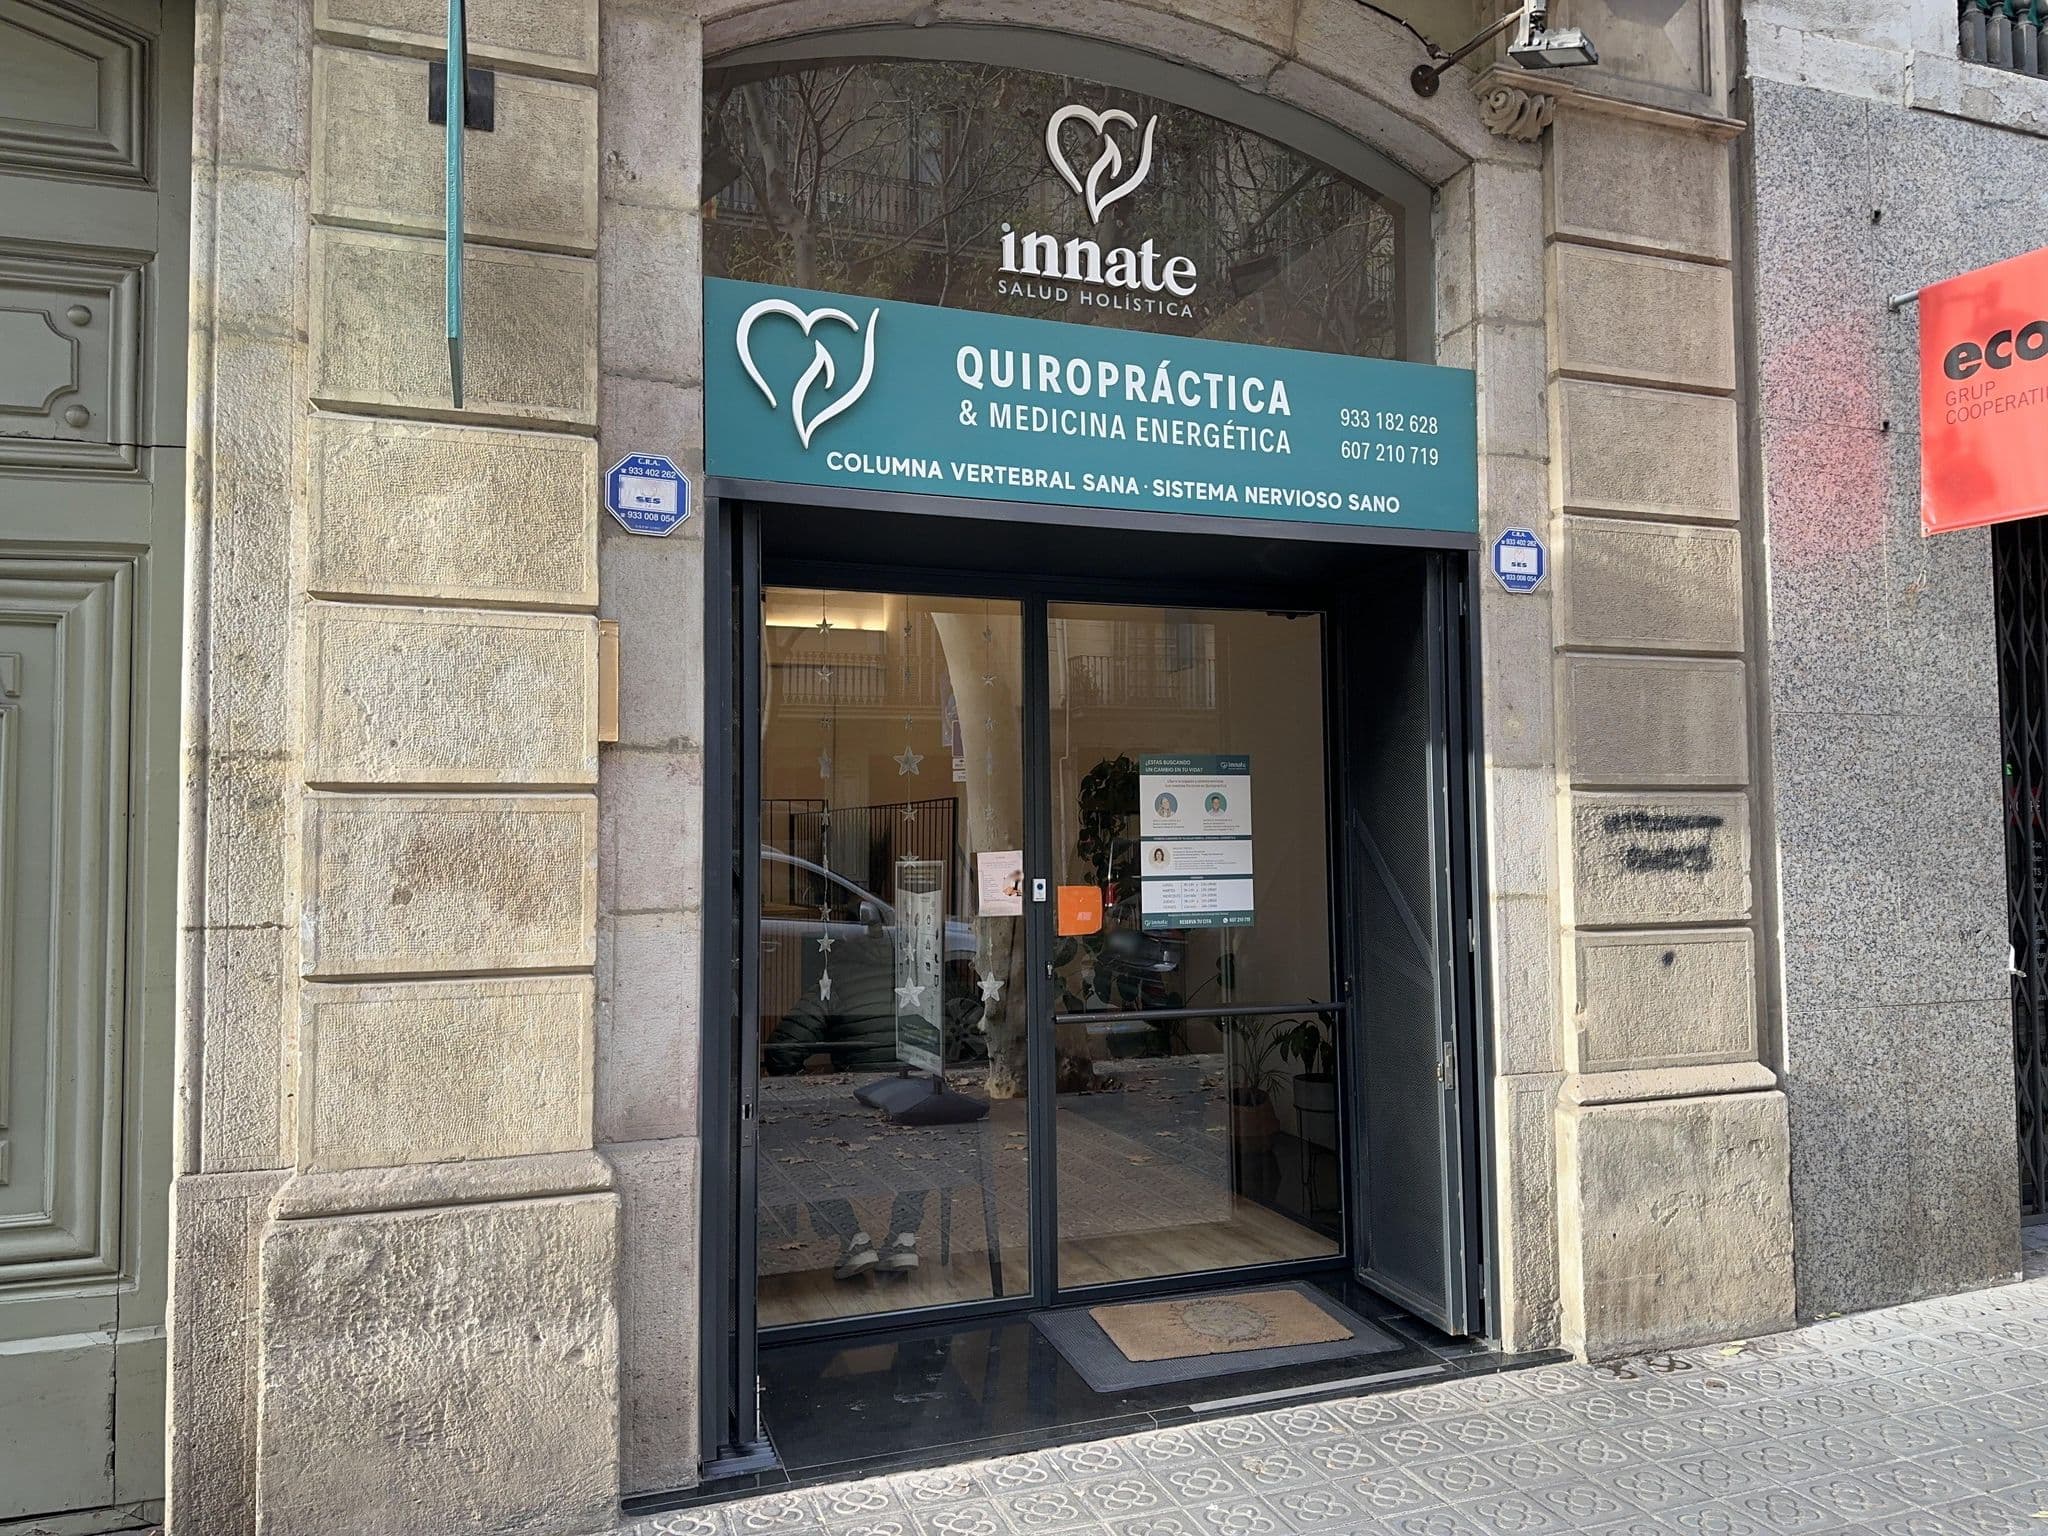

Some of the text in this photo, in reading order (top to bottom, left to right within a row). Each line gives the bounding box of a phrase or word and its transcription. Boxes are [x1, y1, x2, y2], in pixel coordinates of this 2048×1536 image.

[999, 222, 1198, 297] innate
[998, 279, 1194, 319] SALUD HOLÍSTICA
[956, 344, 1292, 417] QUIROPRÁCTICA
[1945, 380, 1995, 406] GRUP
[1340, 408, 1439, 435] 933 182 628
[1945, 385, 2048, 425] COOPERATI
[958, 399, 1292, 456] & MEDICINA ENERGÉTICA
[1341, 440, 1439, 466] 607 210 719
[628, 466, 677, 479] 933 402 262
[826, 451, 944, 481] COLUMNA
[950, 461, 1076, 491] VERTEBRAL
[1081, 473, 1140, 496] SANA
[1152, 478, 1240, 503] SISTEMA
[1245, 485, 1344, 511] NERVIOSO
[1348, 493, 1400, 514] SANO
[627, 510, 675, 523] 933 008 054
[635, 495, 661, 505] SES
